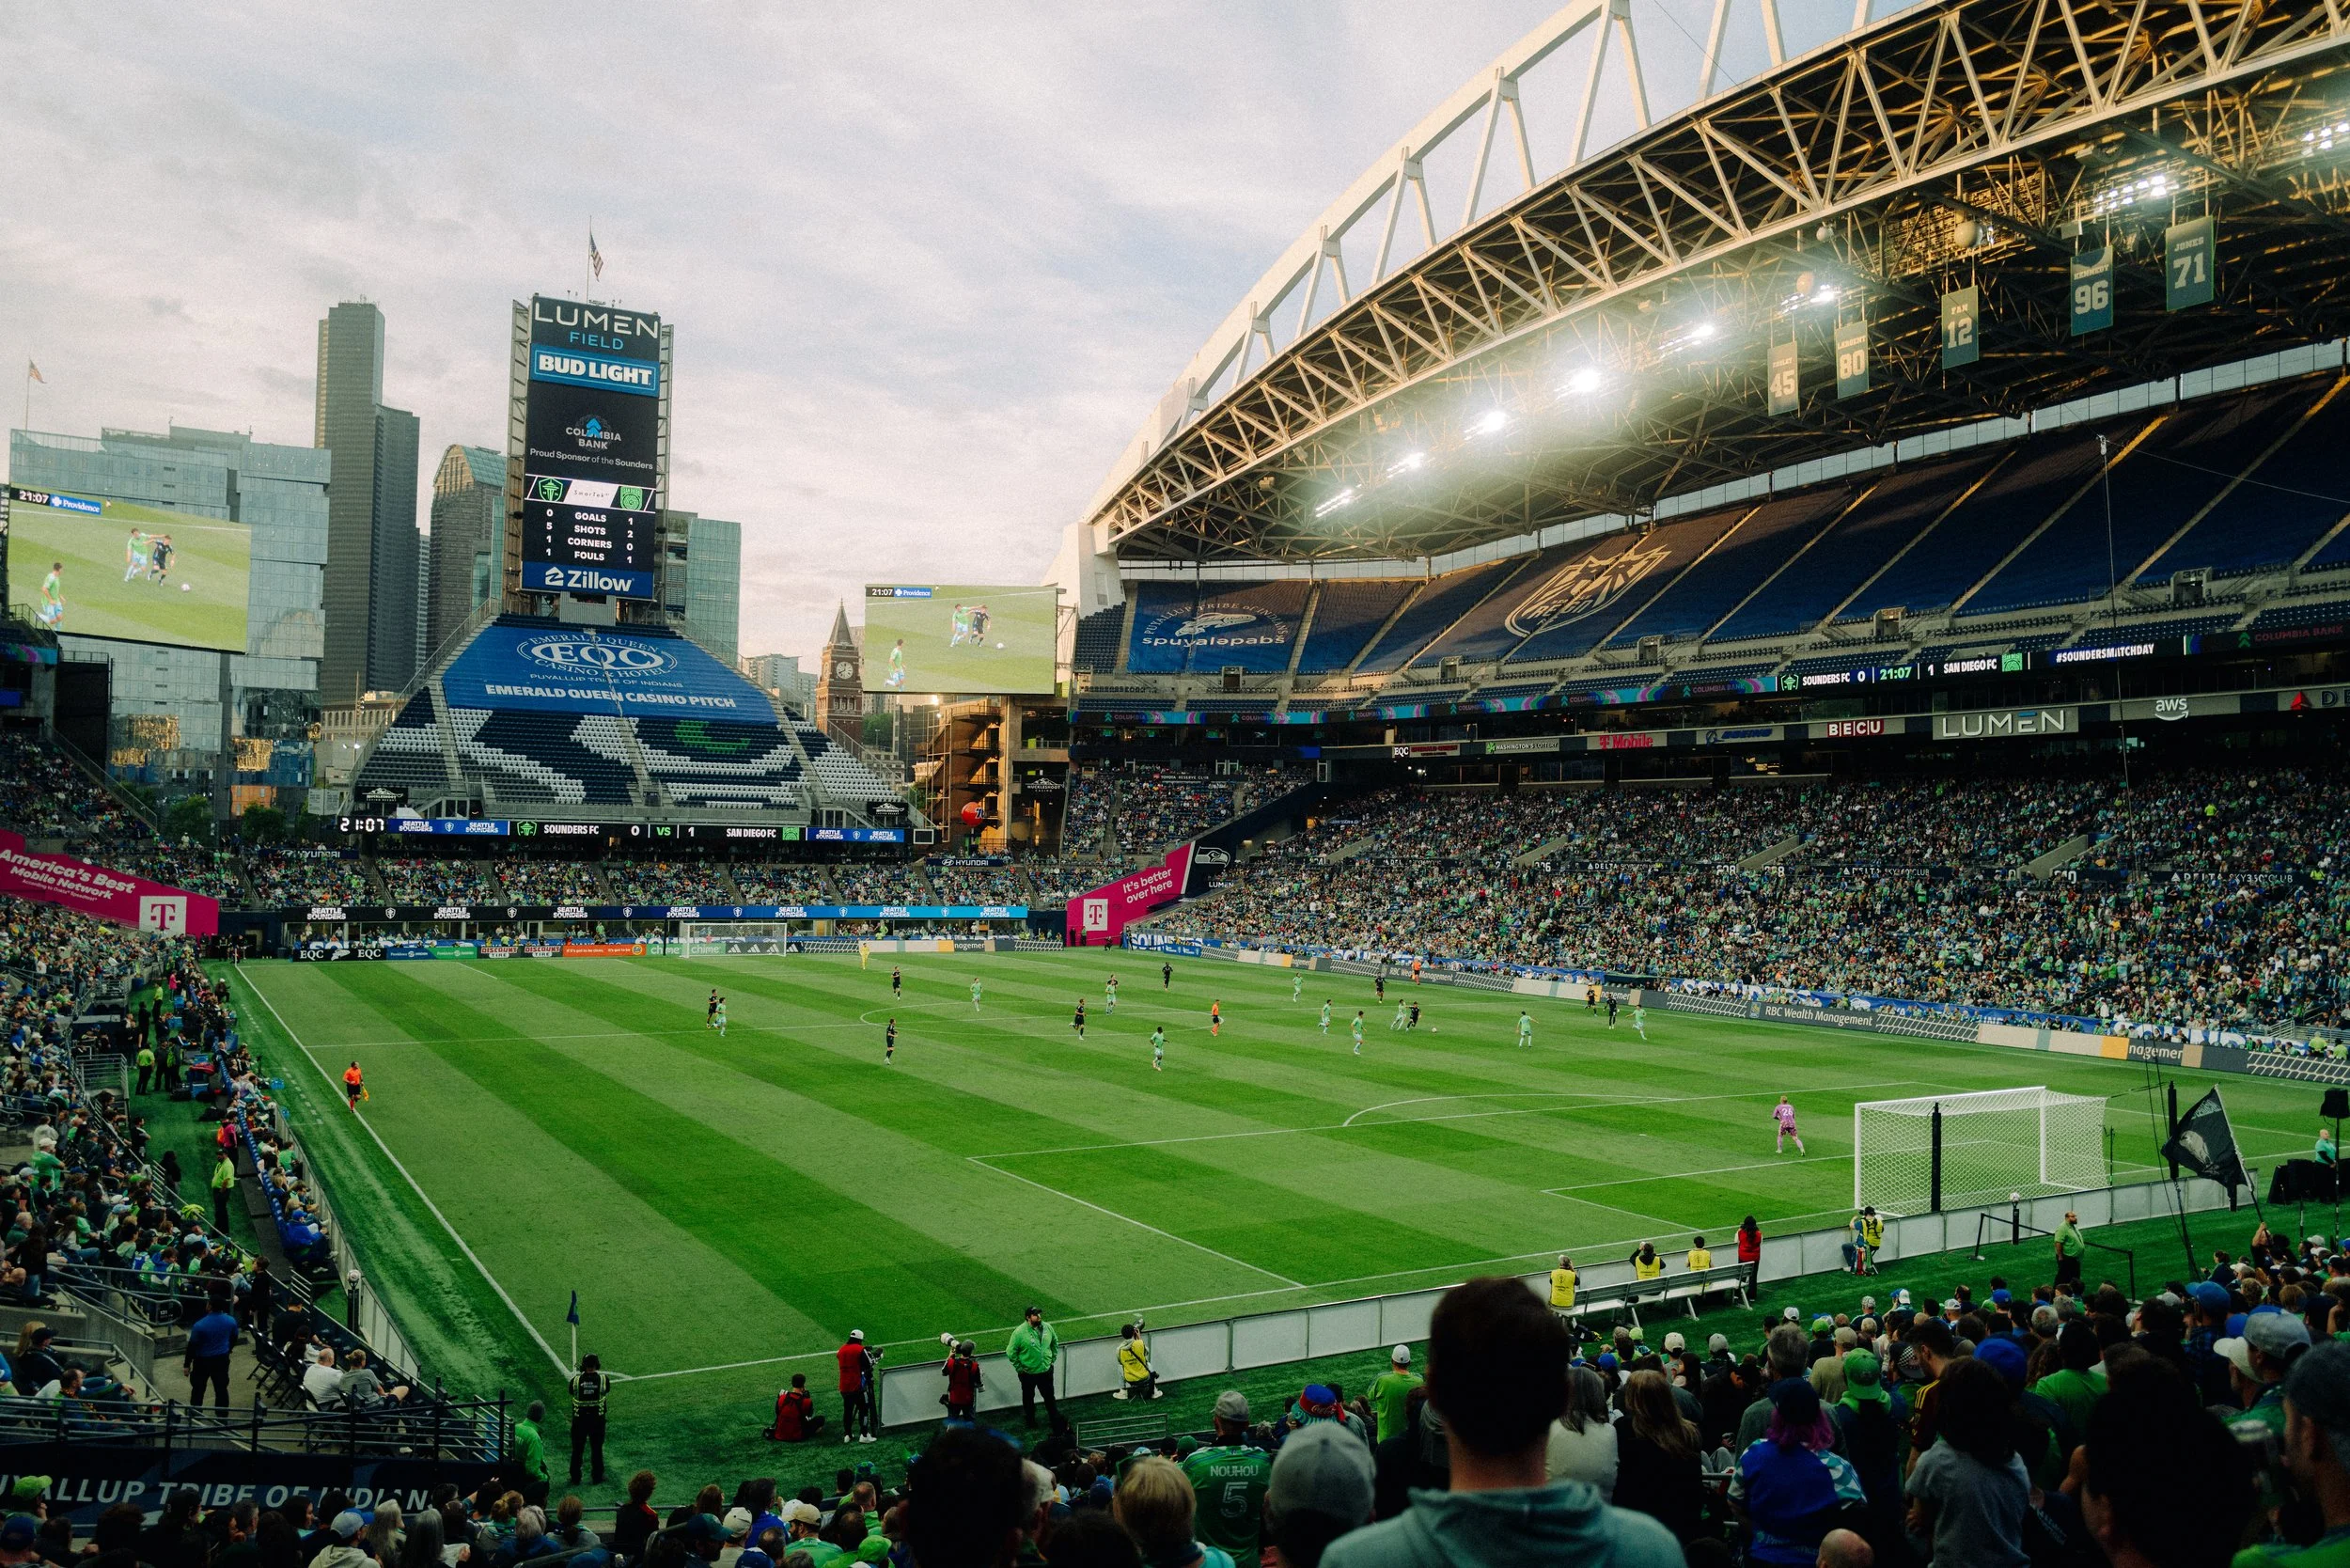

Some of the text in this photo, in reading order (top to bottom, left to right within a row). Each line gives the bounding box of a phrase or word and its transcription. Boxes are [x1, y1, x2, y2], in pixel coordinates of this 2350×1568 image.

[2173, 236, 2204, 252] JONES
[2074, 263, 2109, 280] KENNEDY
[2172, 252, 2206, 290] 71
[2075, 279, 2108, 315] 96
[534, 302, 658, 339] LUMEN
[570, 331, 624, 351] FIELD
[1947, 316, 1973, 349] 12
[539, 353, 652, 385] BUD LIGHT
[1840, 349, 1865, 380] 80
[1770, 369, 1795, 398] 45
[578, 438, 608, 449] BANK
[529, 448, 653, 470] Proud Sponsor of the Sounders
[19, 490, 101, 513] 21:07 Providence
[546, 509, 633, 525] 0 GOALS 1
[574, 525, 606, 536] SHOTS
[627, 530, 633, 539] 2
[546, 535, 552, 543] 1
[568, 537, 612, 549] CORNERS
[574, 551, 604, 561] FOULS
[627, 556, 632, 564] 1
[568, 570, 633, 592] Zillow
[871, 588, 932, 598] 21:07 Providence
[1196, 603, 1240, 611] TRIBE
[1256, 607, 1288, 635] INDIANS
[529, 634, 659, 652] EMERALD QUEEN
[2056, 643, 2154, 664] #SOUNDERSMATCHDAY
[529, 673, 586, 682] PUYALLUP
[535, 659, 599, 676] CASINO
[619, 667, 672, 678] HOTEL
[1802, 658, 1998, 686] SOUNDERS FC 0 21:07 1 SAN DIEGO FC
[485, 684, 737, 708] EMERALD QUEEN CASINO PITCH
[2155, 698, 2187, 712] aws
[1942, 710, 2066, 737] LUMEN
[1496, 743, 1535, 751] WASHINGTON'S
[1612, 732, 1653, 749] Mobile
[1394, 746, 1409, 757] EQC
[339, 817, 384, 833] 21:07
[543, 823, 776, 839] SOUNDERS FC 0 VS 1 SAN DIEGO FC
[0, 849, 136, 894] America's Best
[1122, 868, 1172, 894] It's better
[10, 866, 115, 900] Mobile Network
[1126, 880, 1173, 904] over here
[300, 949, 324, 960] EQC
[357, 949, 382, 959] EQC
[692, 945, 720, 954] chime
[1389, 967, 1401, 976] RBC
[1765, 1005, 1873, 1027] RBC Wealth Management
[1210, 1465, 1259, 1478] NOUHOU
[1221, 1482, 1249, 1519] 5
